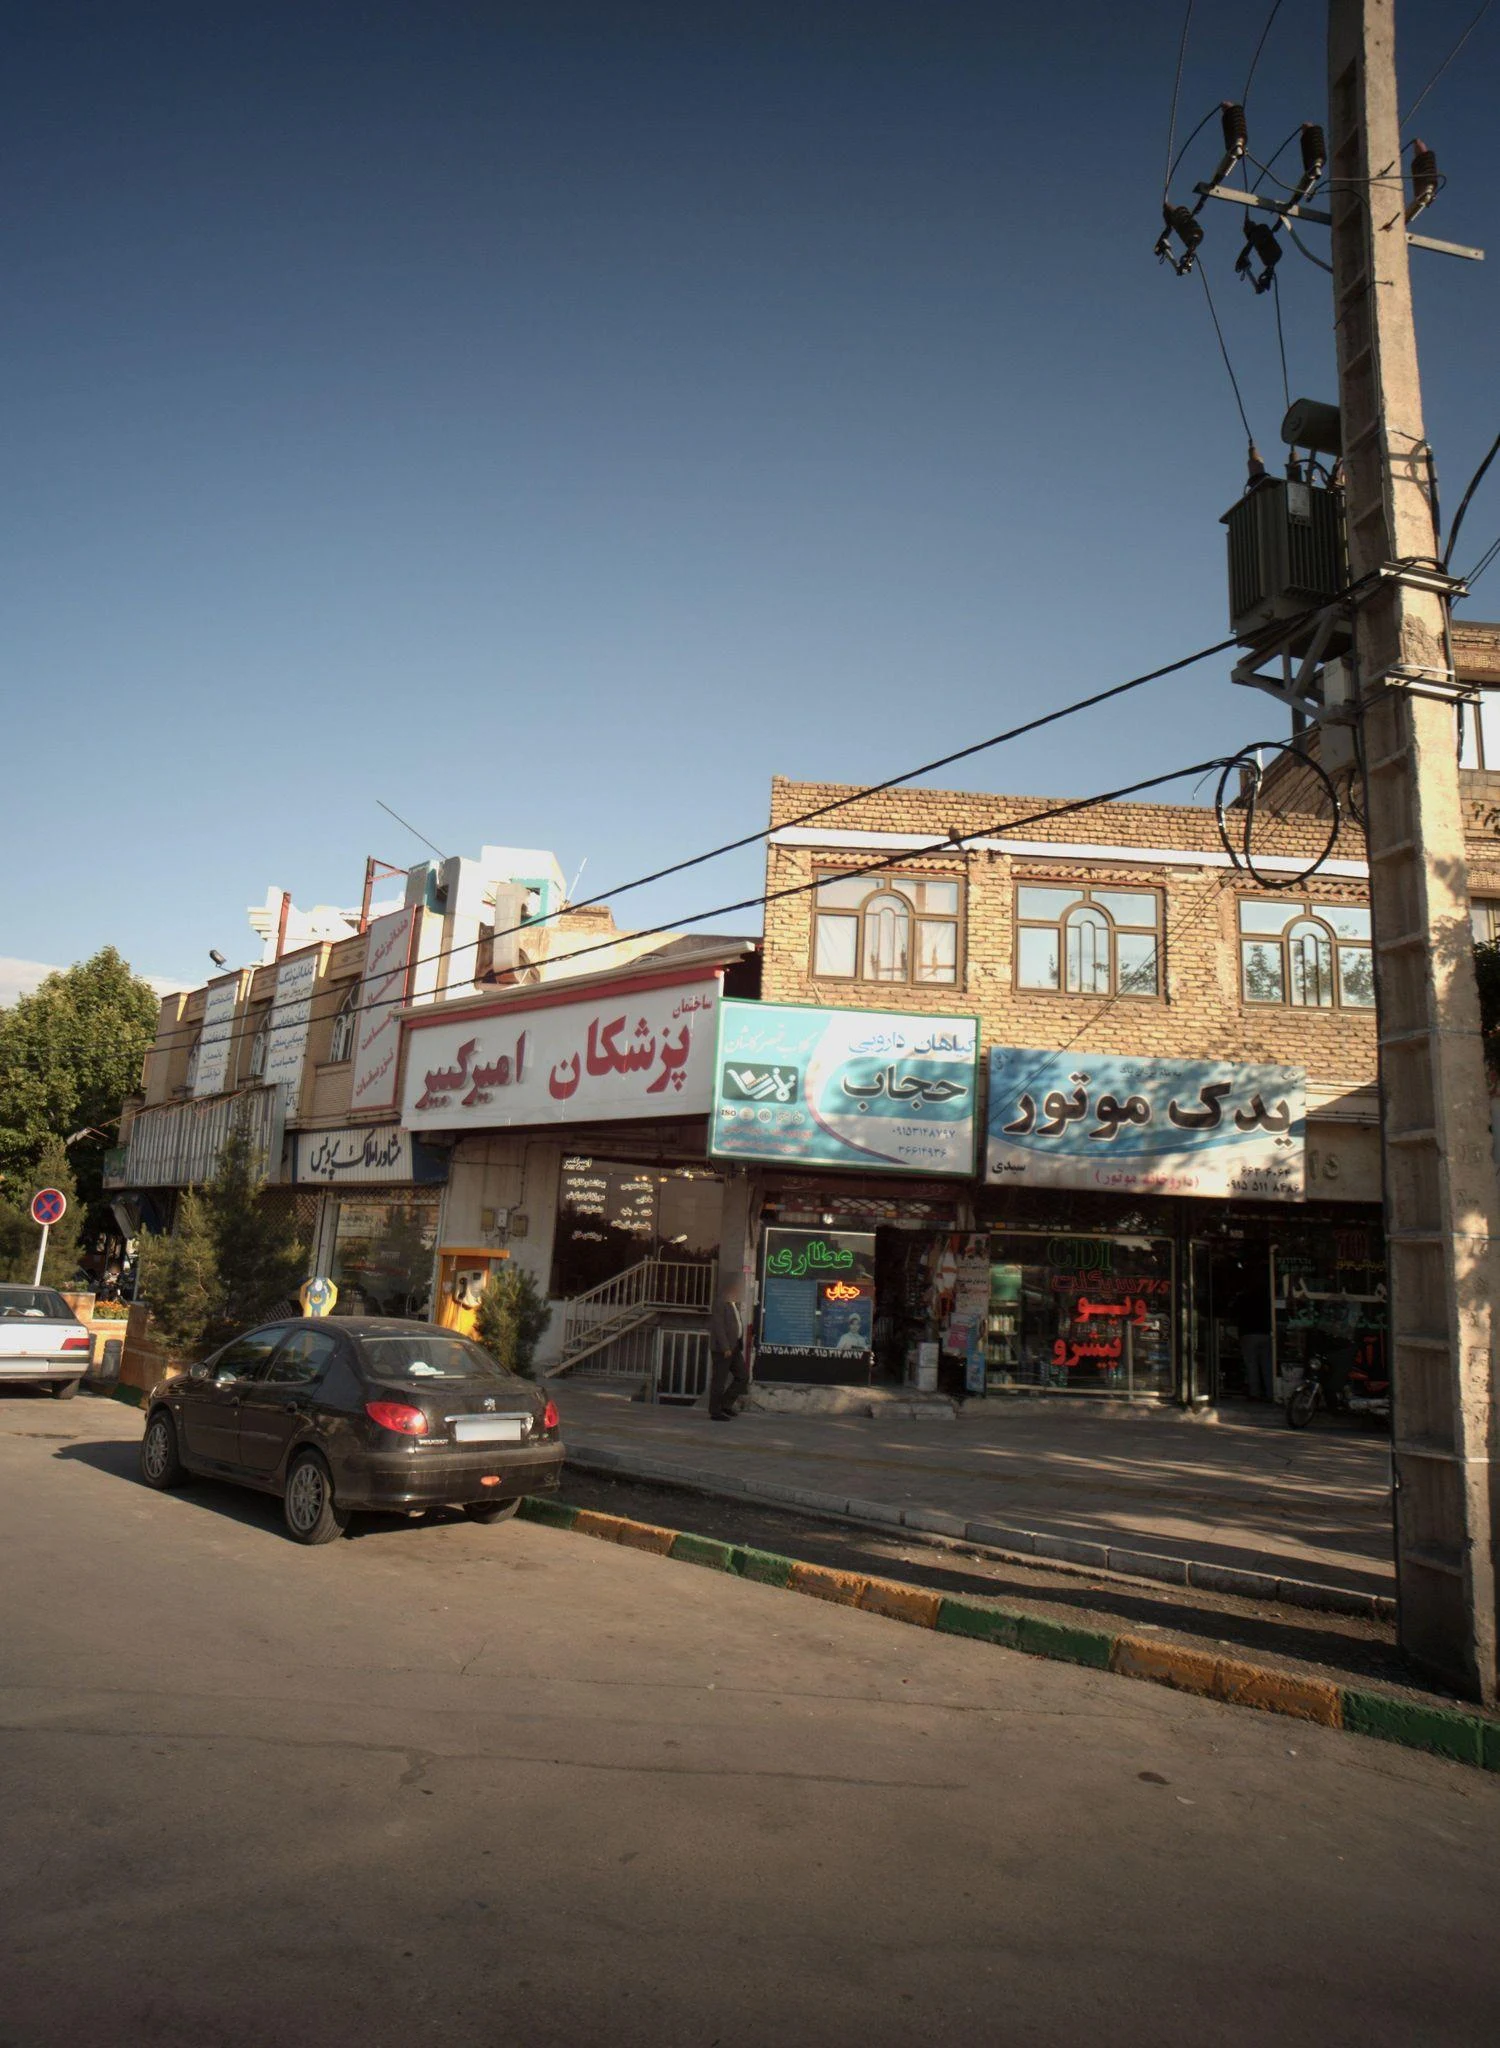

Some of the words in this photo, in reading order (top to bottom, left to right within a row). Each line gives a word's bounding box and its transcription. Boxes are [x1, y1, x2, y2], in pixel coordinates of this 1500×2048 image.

[672, 996, 713, 1019] ساختمان
[415, 1030, 527, 1110] امیرکبیر
[549, 1015, 692, 1100] پزشکان
[842, 1063, 968, 1112] حجاب
[1002, 1071, 1153, 1141] موتور
[1168, 1081, 1296, 1148] یدک
[768, 1240, 854, 1275] عطاری
[1047, 1237, 1113, 1270] CDI
[825, 1281, 861, 1301] حجاب
